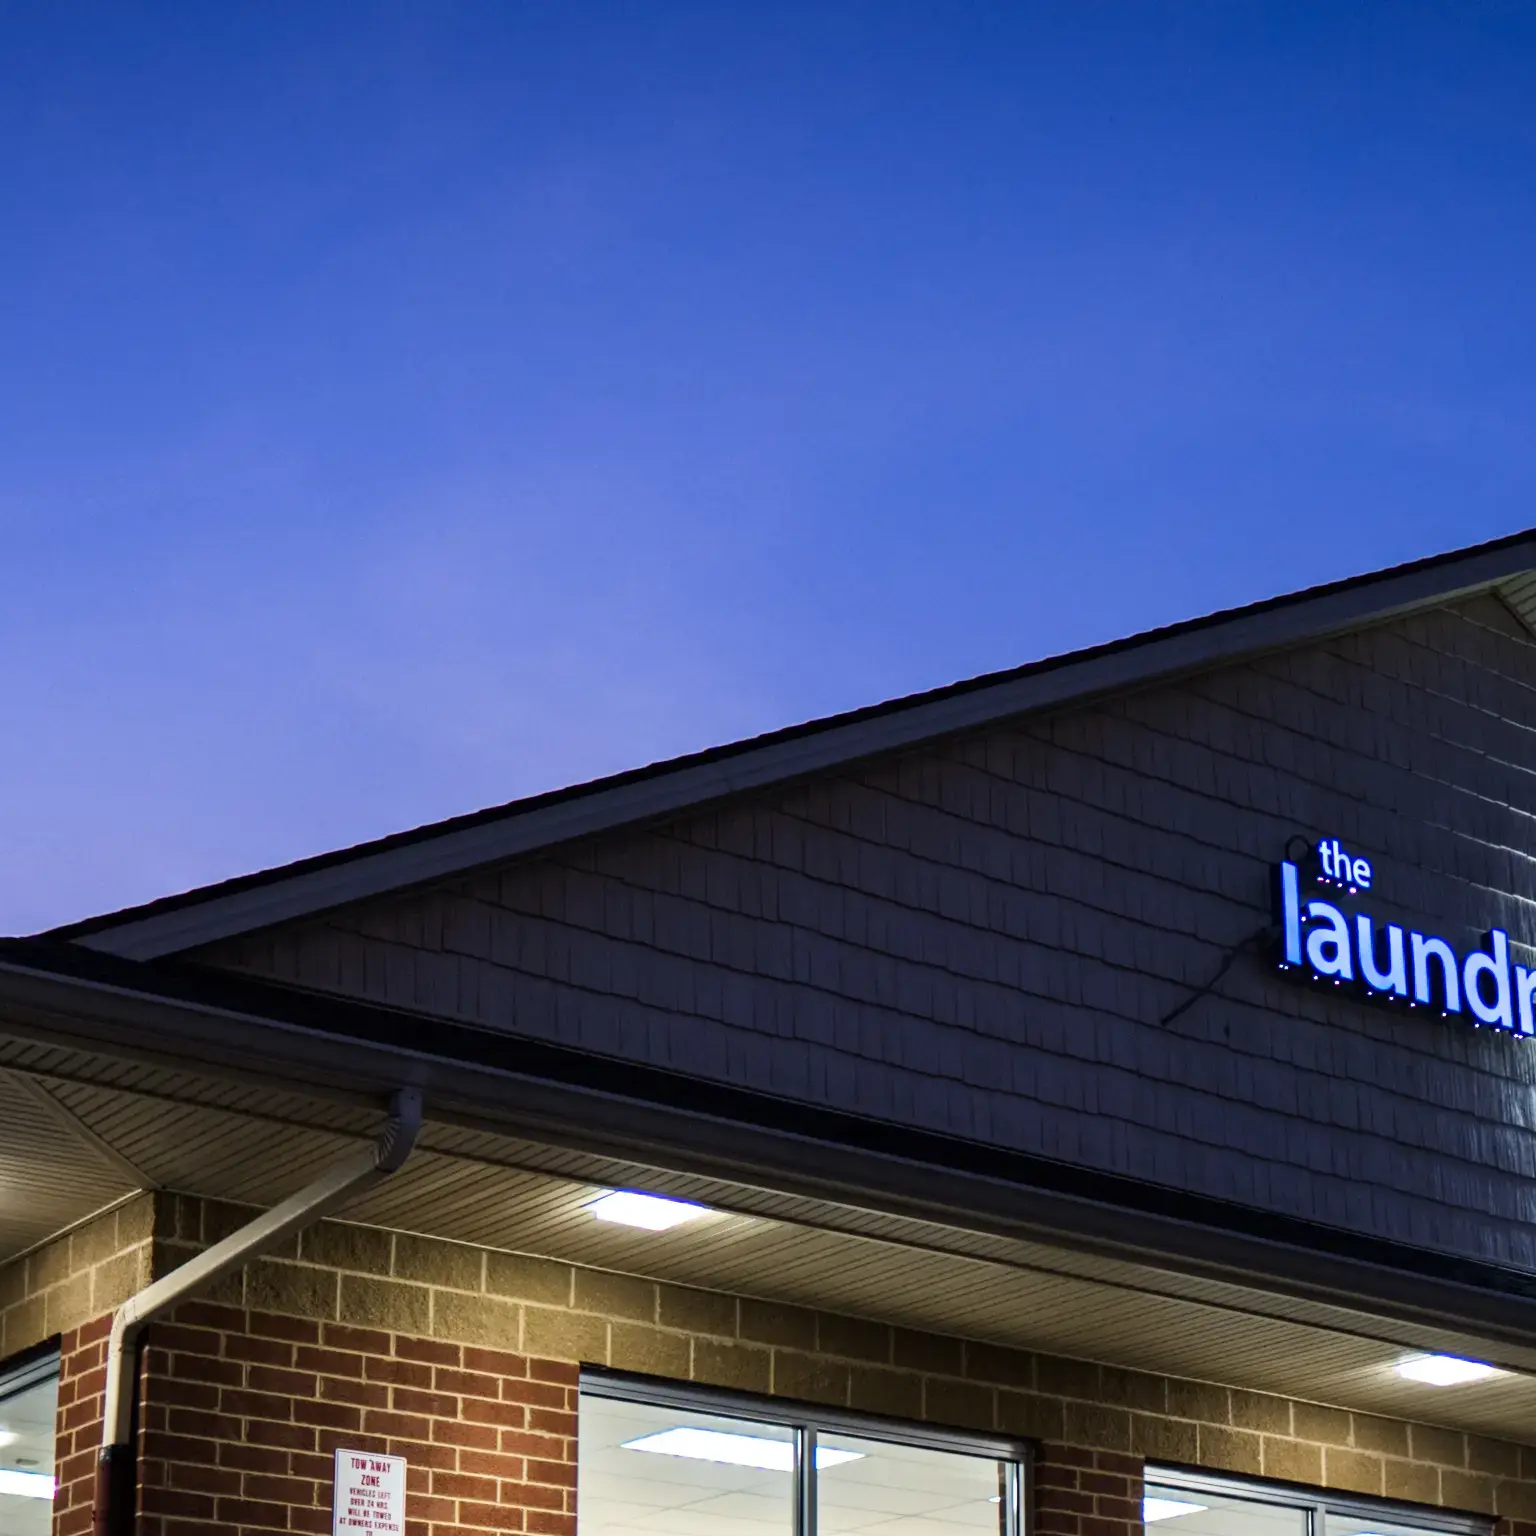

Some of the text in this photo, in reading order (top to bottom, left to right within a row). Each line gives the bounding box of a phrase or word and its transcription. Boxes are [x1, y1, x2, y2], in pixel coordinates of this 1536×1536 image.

[1318, 839, 1371, 888] the
[351, 1458, 391, 1473] TOW AWAY
[361, 1474, 380, 1487] ZONE
[350, 1488, 376, 1498] VEHICLES
[350, 1498, 365, 1506] OVER
[348, 1508, 391, 1520] WILL BE TOWED
[339, 1516, 346, 1524] AT
[374, 1521, 399, 1531] EXPENSE
